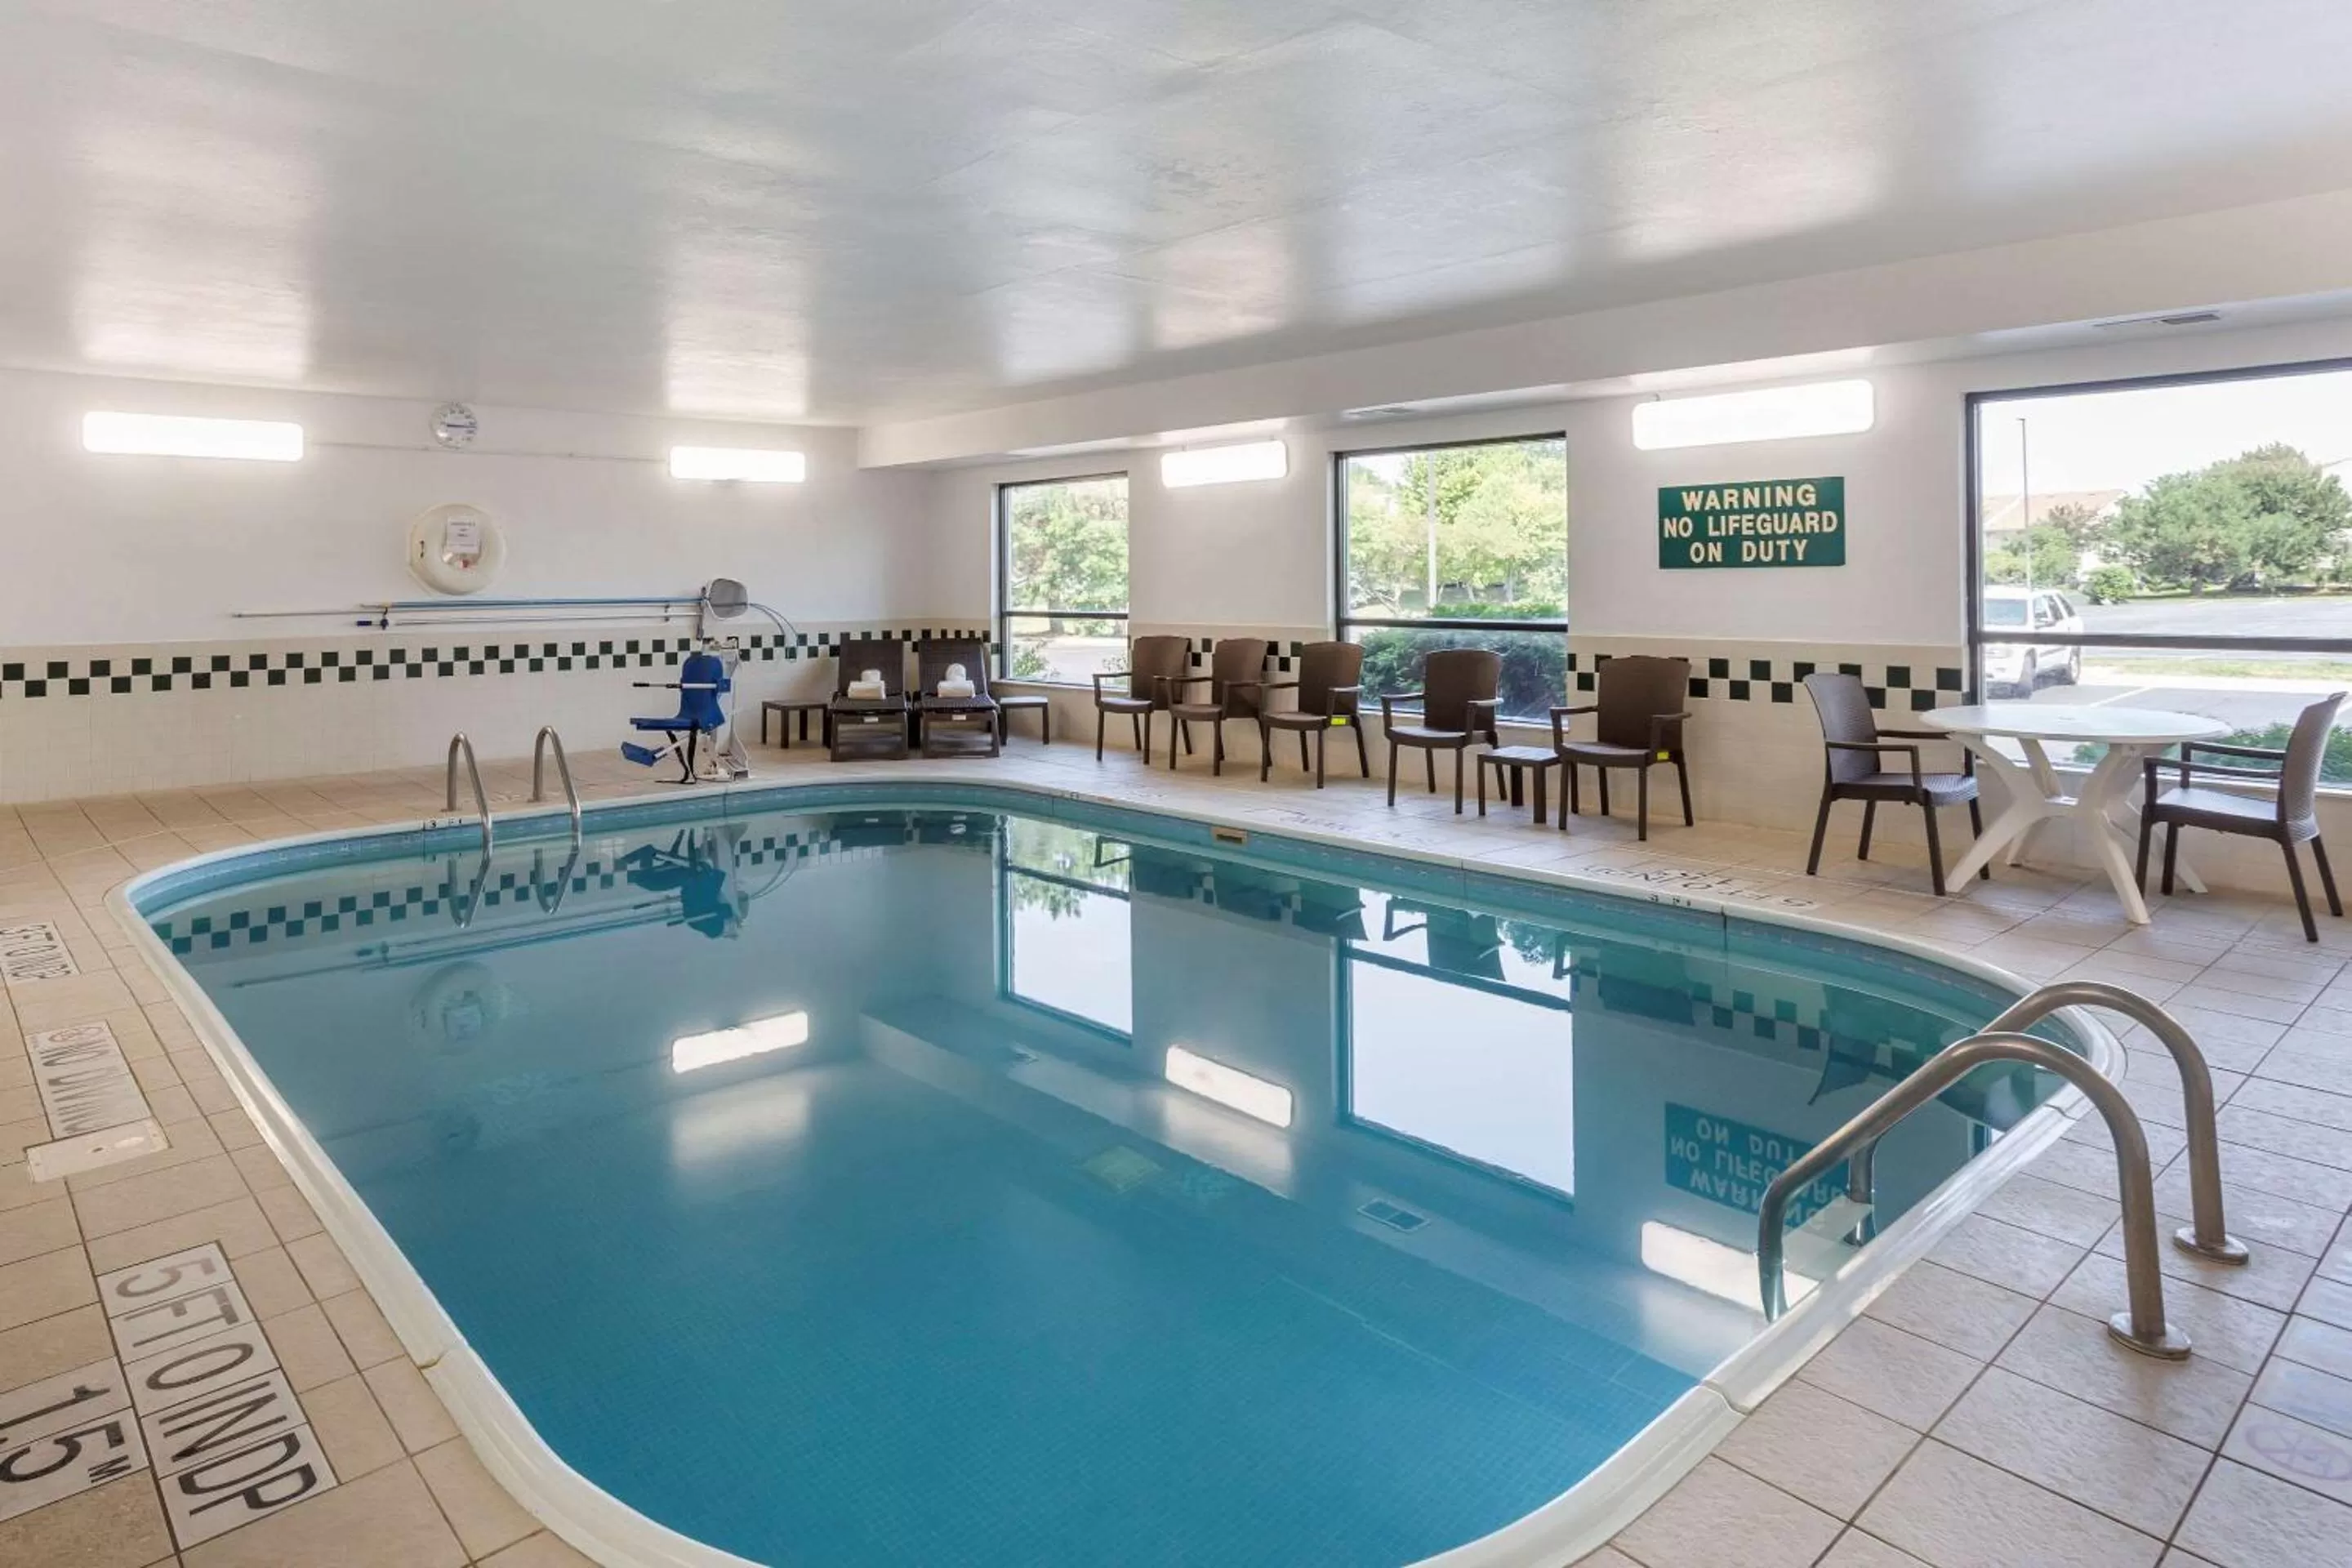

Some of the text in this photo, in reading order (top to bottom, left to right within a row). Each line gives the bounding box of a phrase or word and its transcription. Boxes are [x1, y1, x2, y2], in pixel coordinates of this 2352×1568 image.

[1682, 483, 1816, 511] WARNING
[1664, 510, 1838, 538] NO LIFEGUARD
[1690, 539, 1809, 564] ON DUTY
